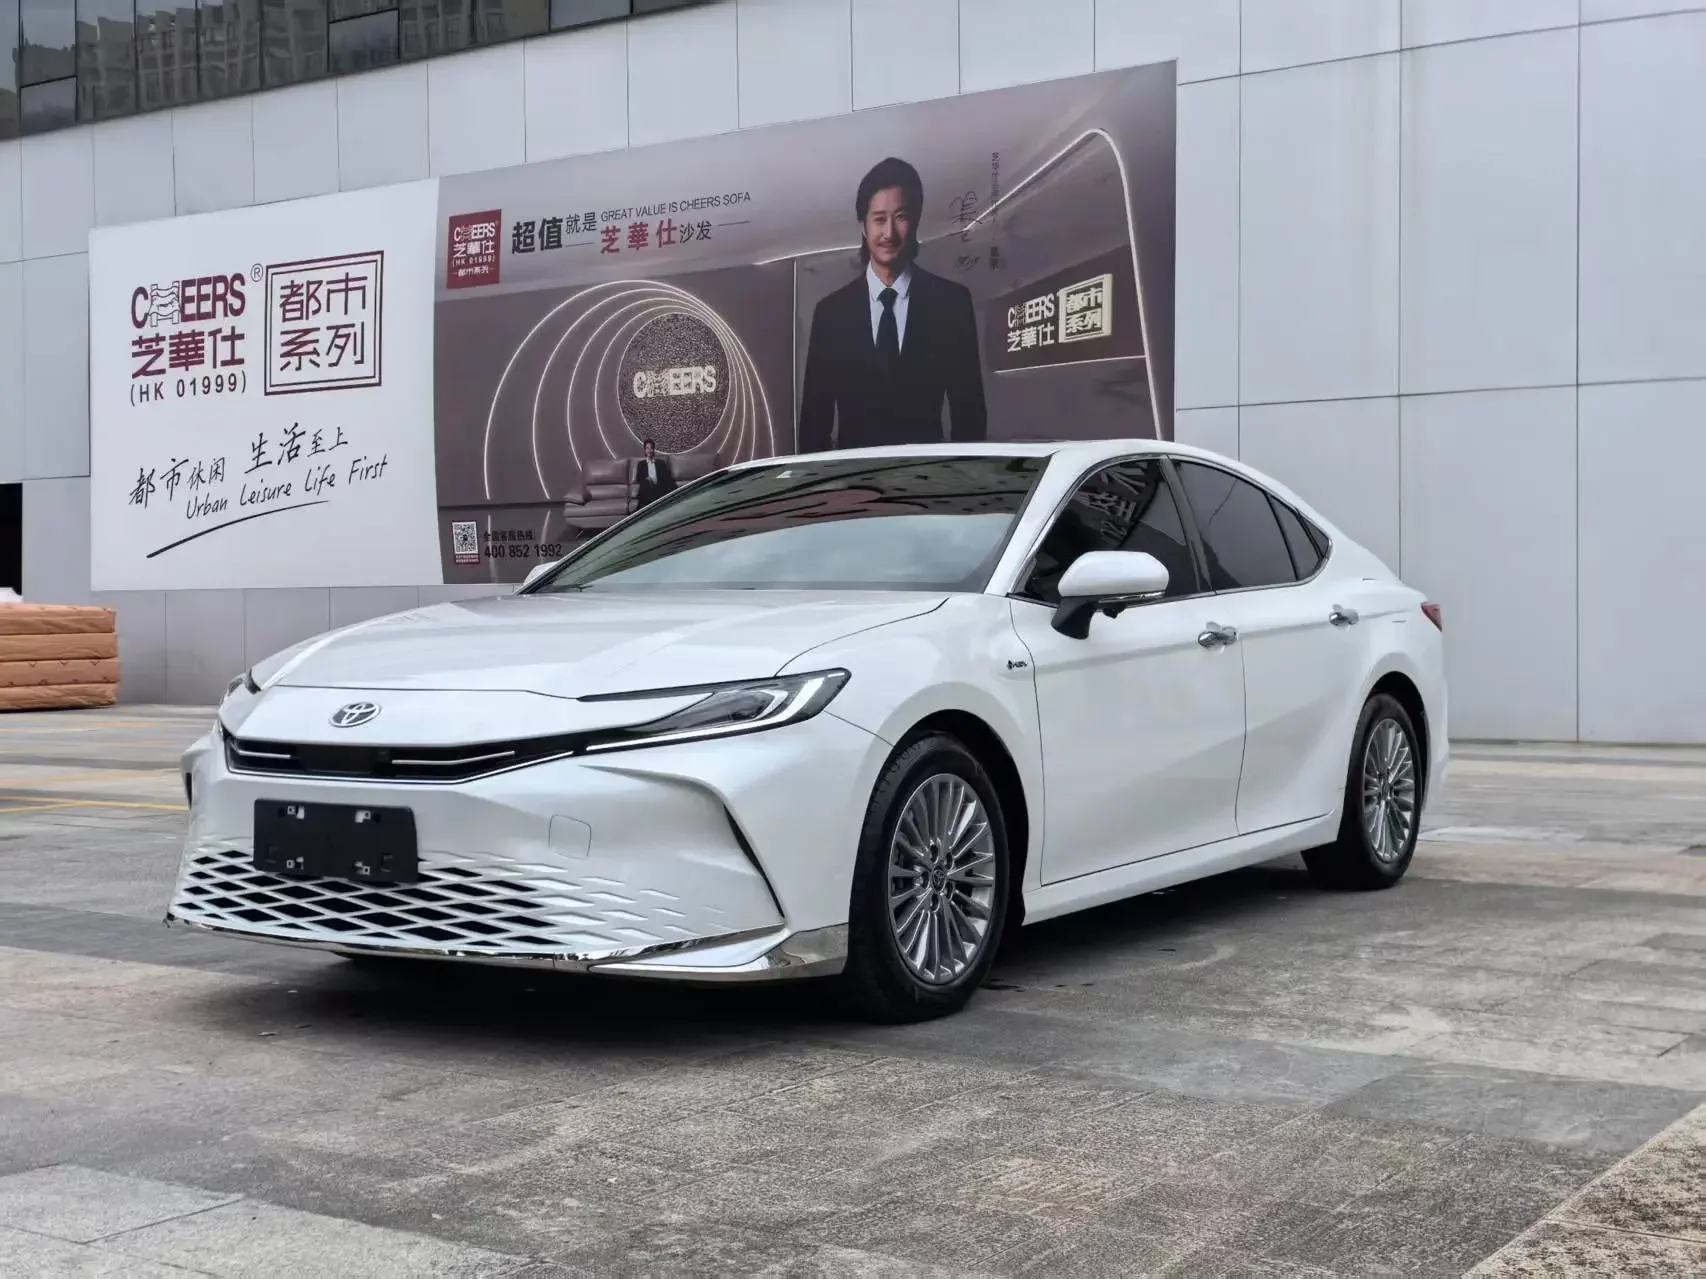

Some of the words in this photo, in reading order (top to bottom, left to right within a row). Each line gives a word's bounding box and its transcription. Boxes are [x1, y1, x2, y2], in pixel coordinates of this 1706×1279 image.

[601, 208, 634, 222] GREAT
[635, 202, 666, 216] VALUE
[668, 201, 678, 213] IS
[679, 196, 721, 212] CHEERS
[722, 191, 751, 205] SOFA
[511, 211, 598, 254] 超值就是
[600, 218, 713, 255] 芝華仕沙发
[131, 272, 246, 329] CHEERS
[279, 272, 368, 323] 都市
[131, 325, 245, 379] 芝華仕
[279, 321, 365, 372] 系列
[1007, 323, 1055, 352] 芝華仕
[130, 380, 165, 407] (HK
[176, 369, 246, 398] 01999)
[633, 365, 717, 398] CHEERS
[128, 456, 226, 509] 都市休闲
[244, 422, 349, 474] 生活至上
[186, 492, 229, 520] Urban
[240, 478, 293, 507] Leisure
[304, 463, 337, 496] Life
[349, 452, 389, 485] First
[483, 544, 506, 558] 400
[508, 544, 530, 558] 852
[533, 543, 563, 557] 1992
